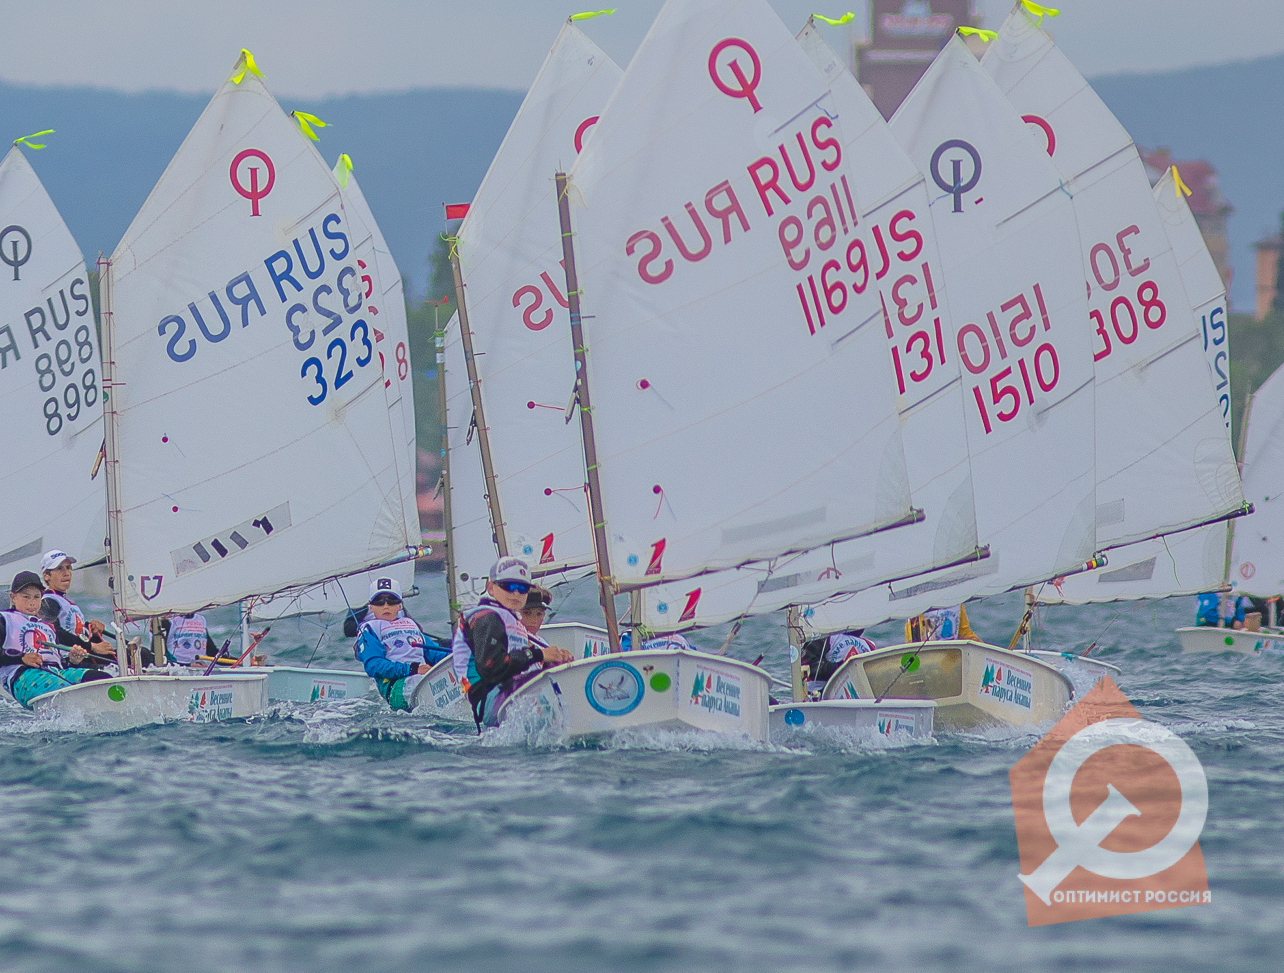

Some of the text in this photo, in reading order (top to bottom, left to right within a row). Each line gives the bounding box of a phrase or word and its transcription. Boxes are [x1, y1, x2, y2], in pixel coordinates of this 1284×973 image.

[746, 116, 842, 217] RUS
[263, 213, 350, 304] RUS
[796, 238, 869, 336] 1169
[23, 277, 90, 350] RUS
[891, 316, 946, 395] 131
[42, 368, 98, 436] 898
[301, 318, 373, 406] 323
[972, 342, 1060, 435] 1510
